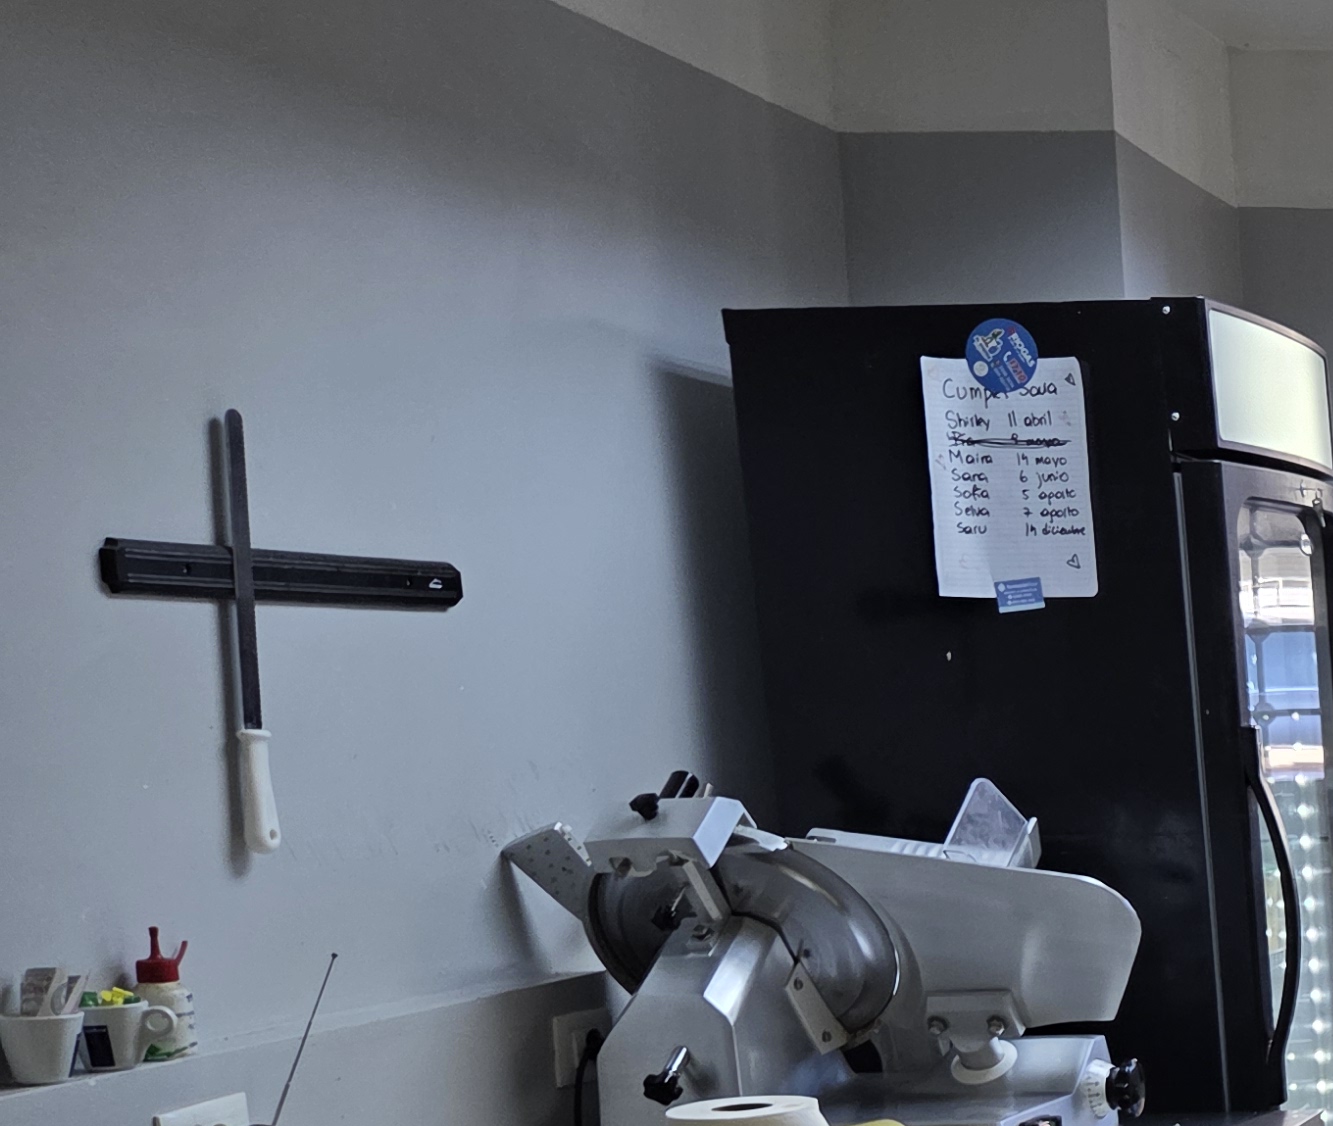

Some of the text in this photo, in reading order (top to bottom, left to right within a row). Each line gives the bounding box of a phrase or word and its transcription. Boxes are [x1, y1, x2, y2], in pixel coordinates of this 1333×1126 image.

[1007, 410, 1018, 427] 11
[1023, 410, 1053, 427] abril
[1035, 456, 1068, 468] mayo
[951, 468, 1070, 489] Sara 6 junio
[1021, 489, 1030, 500] 5
[1023, 507, 1033, 518] 7
[1040, 506, 1079, 524] agosto
